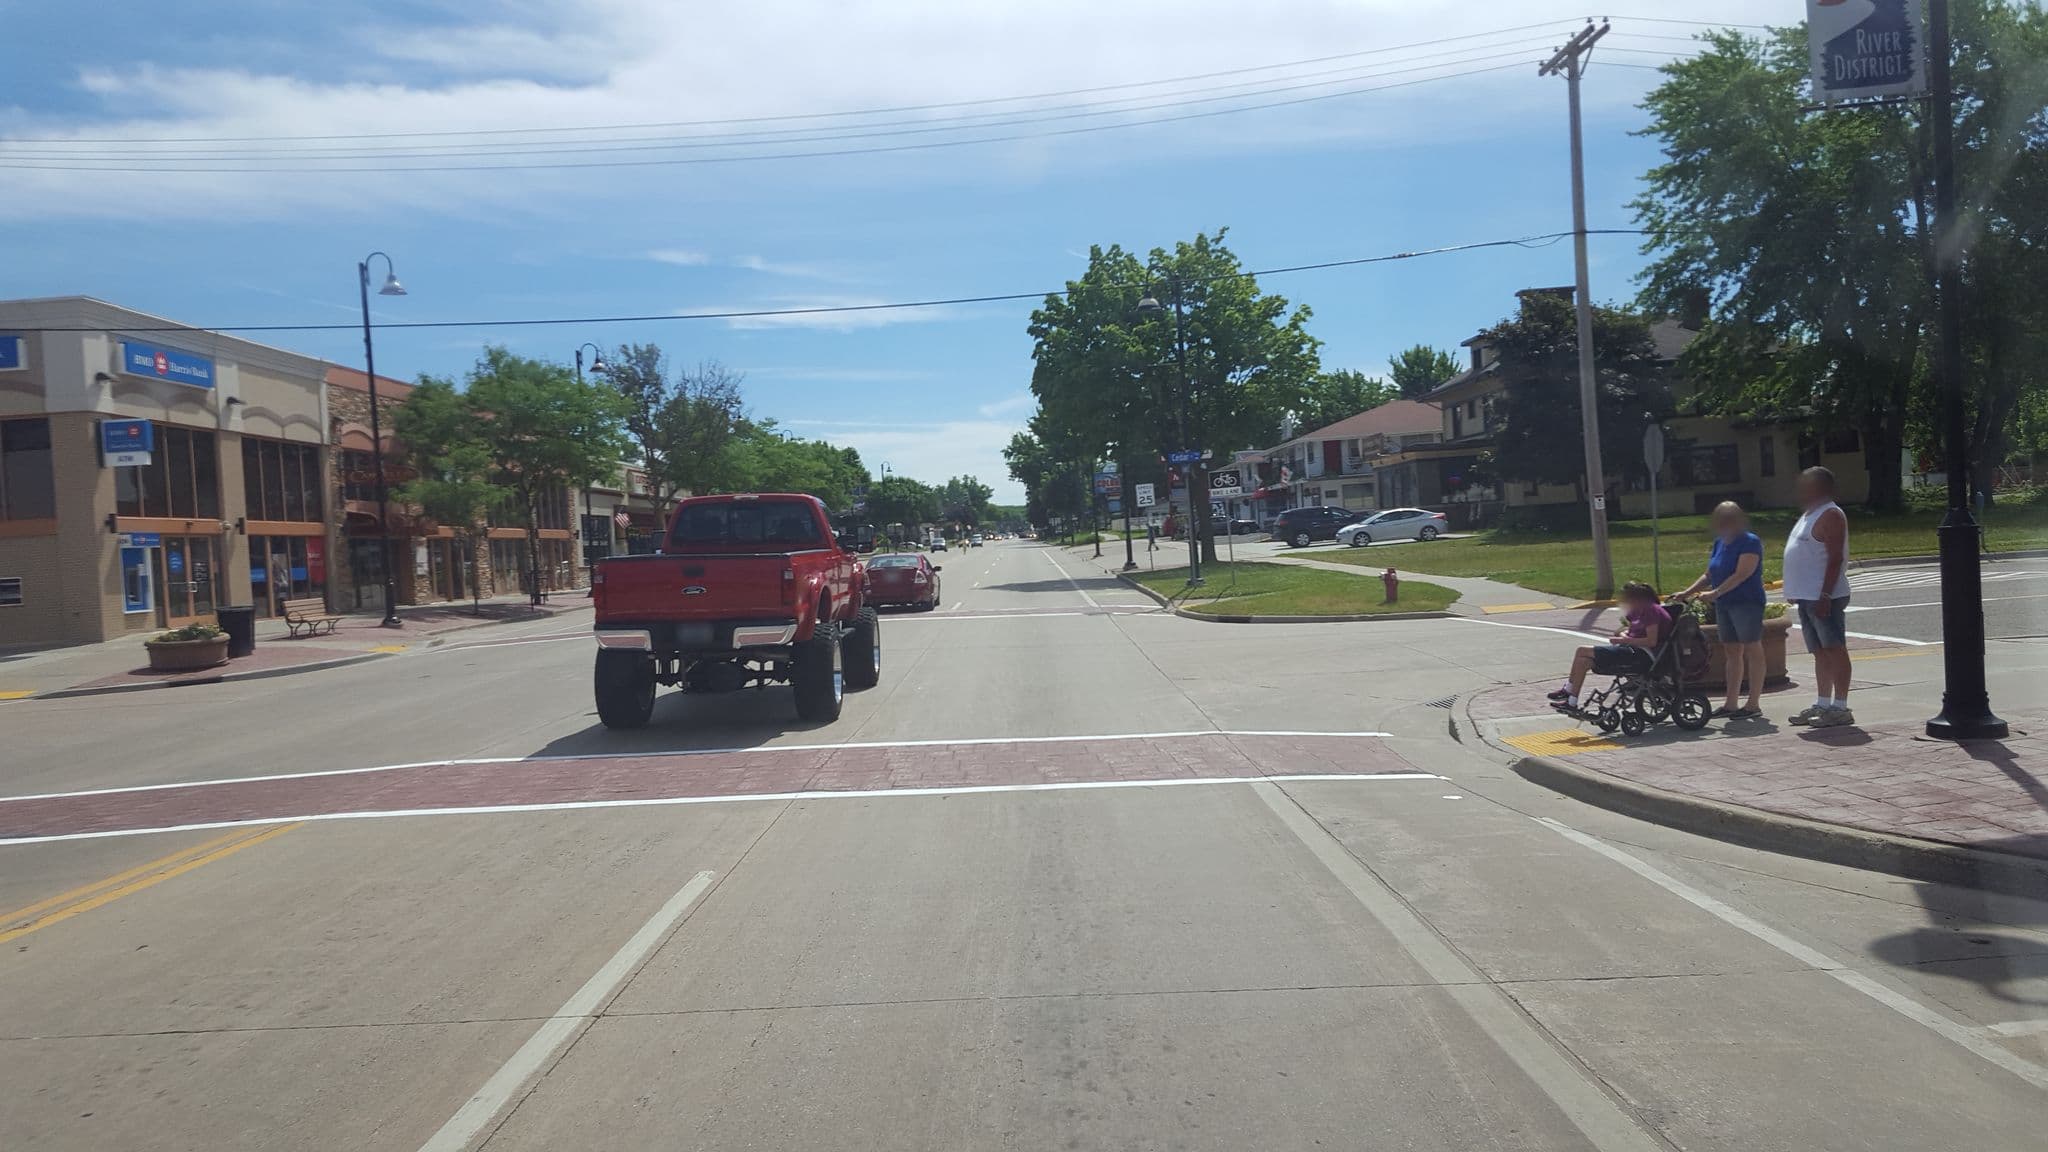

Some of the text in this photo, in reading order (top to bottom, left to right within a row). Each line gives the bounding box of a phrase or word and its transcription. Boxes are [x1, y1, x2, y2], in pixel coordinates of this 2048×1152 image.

[1856, 28, 1902, 54] RIVER
[1834, 53, 1903, 81] DISTRICT
[1139, 495, 1153, 504] 25
[1225, 487, 1240, 495] LANE
